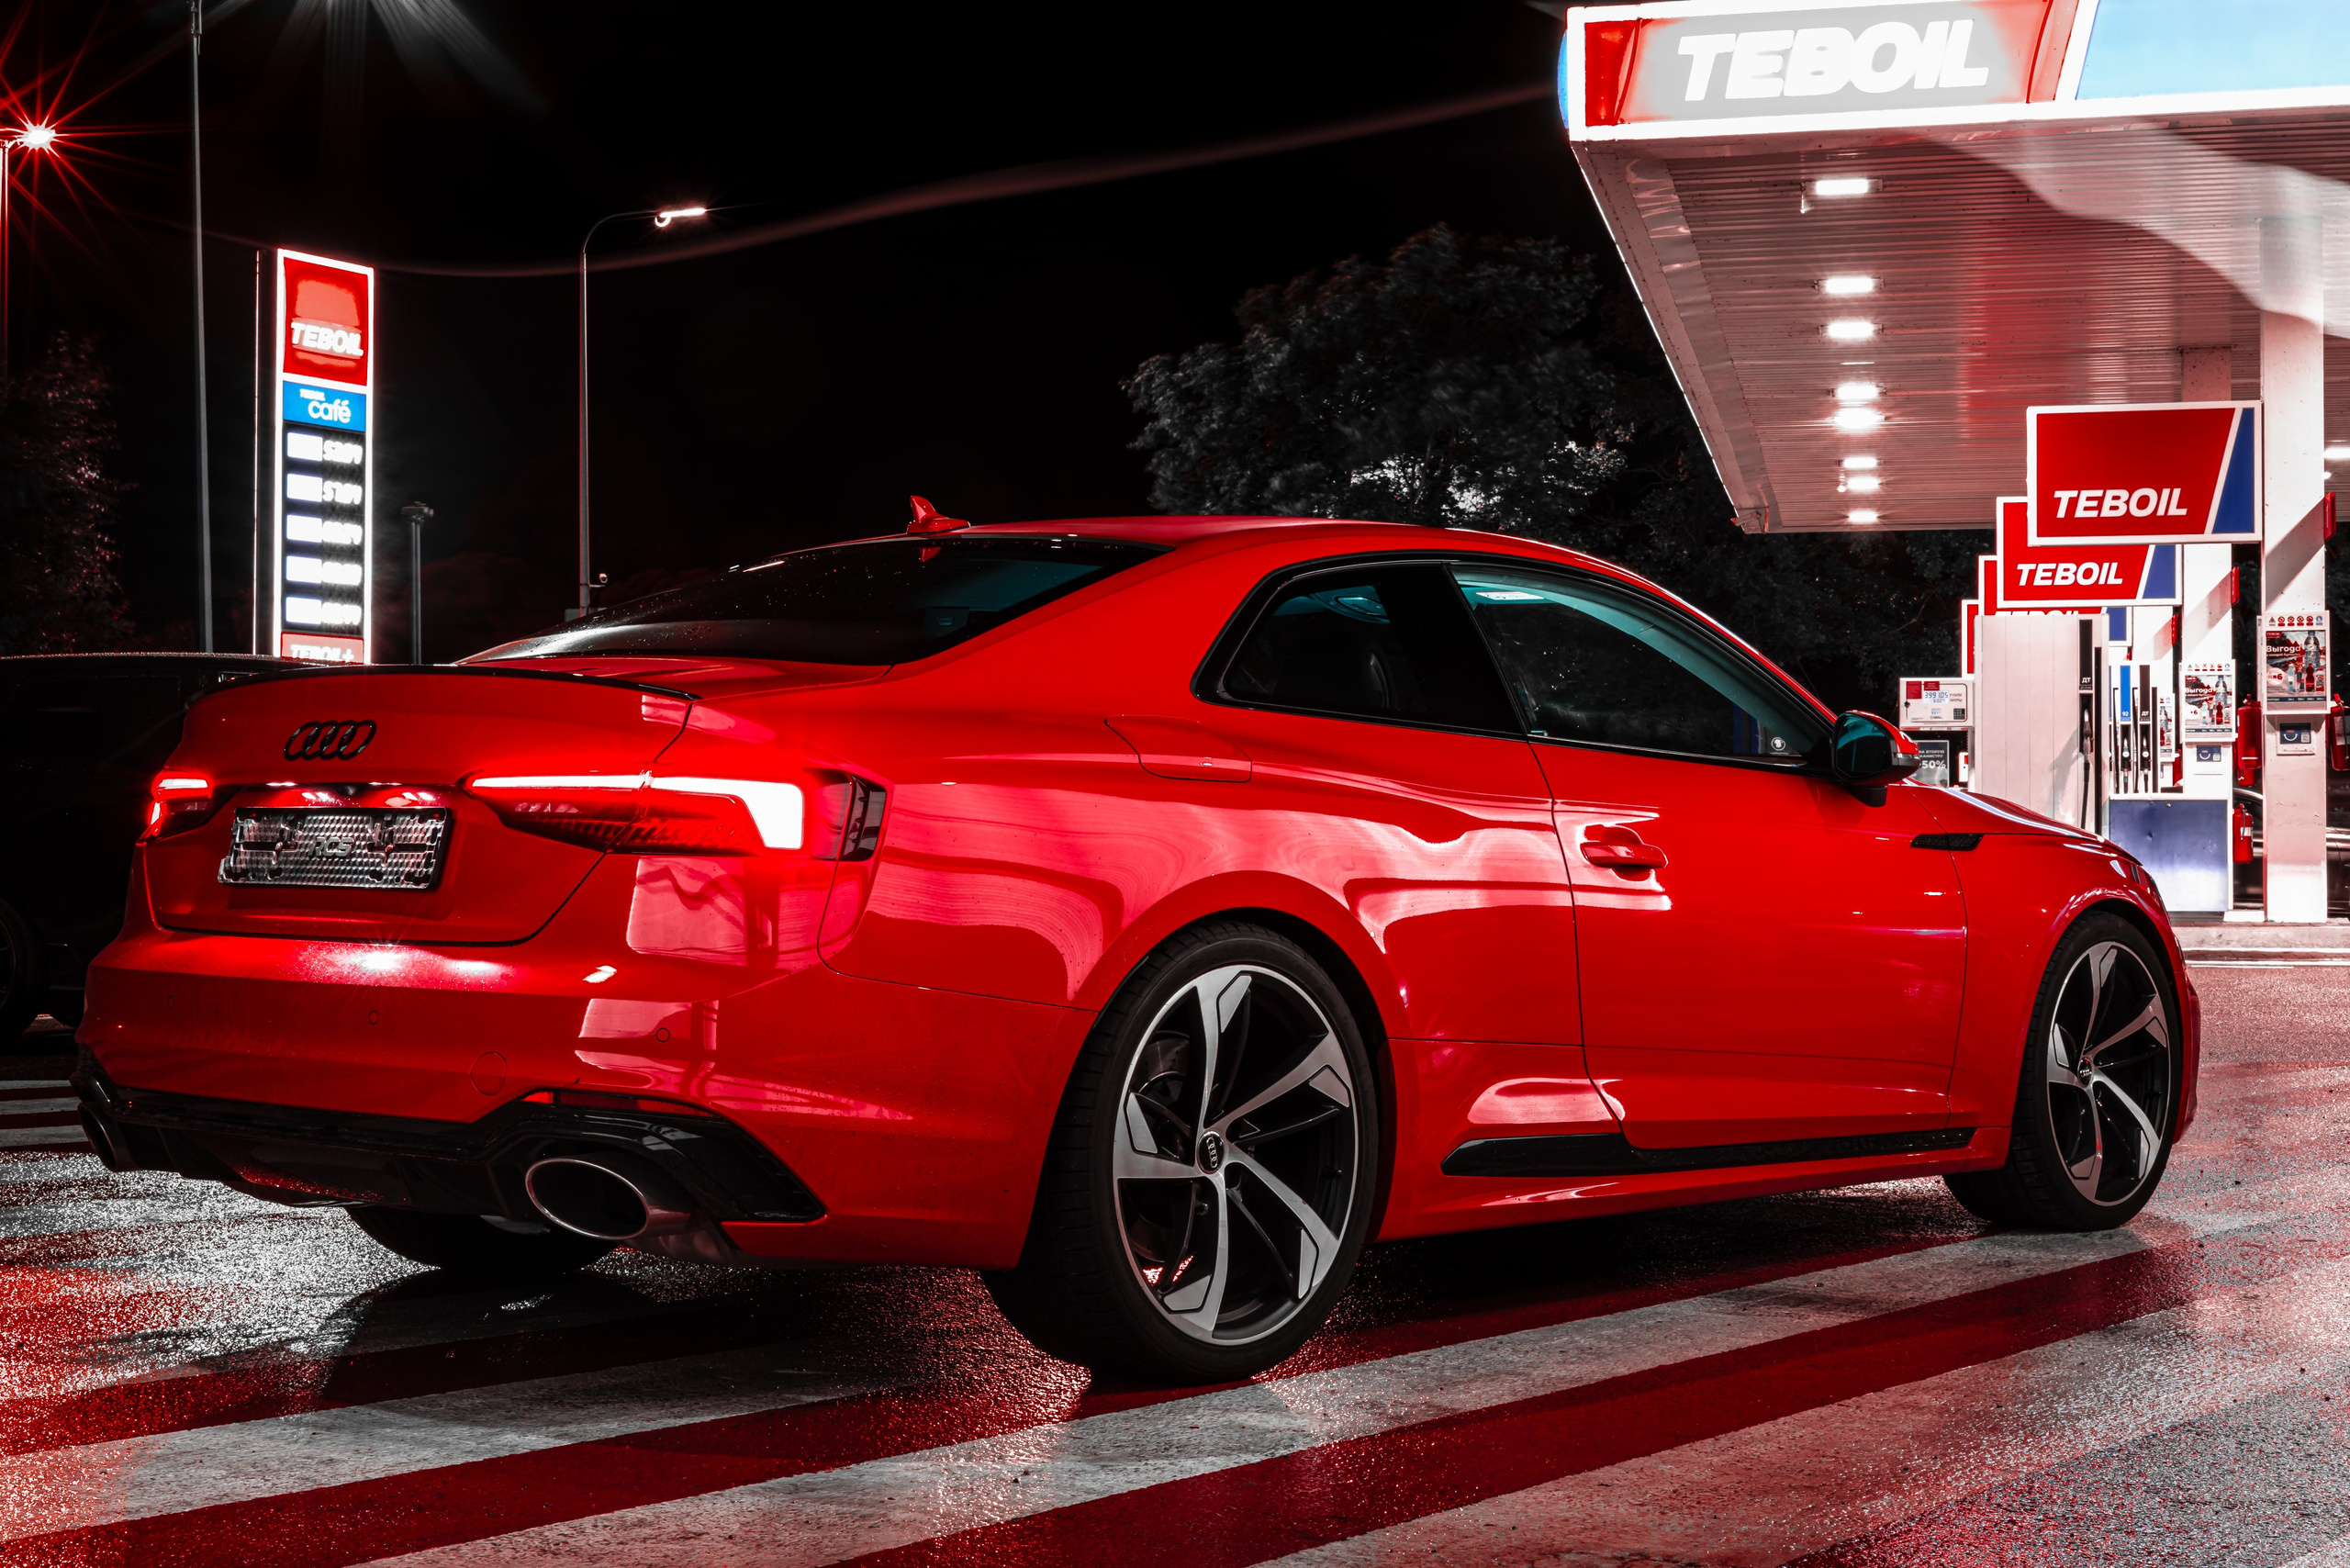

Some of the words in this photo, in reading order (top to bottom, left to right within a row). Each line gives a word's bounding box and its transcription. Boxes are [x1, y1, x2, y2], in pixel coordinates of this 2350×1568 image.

[1678, 19, 1988, 101] TEBOIL
[291, 321, 364, 356] TEBOIL
[308, 398, 352, 423] café
[2053, 487, 2188, 518] TEBOIL
[2017, 562, 2123, 586] TEBOIL
[2266, 645, 2301, 654] Выгода
